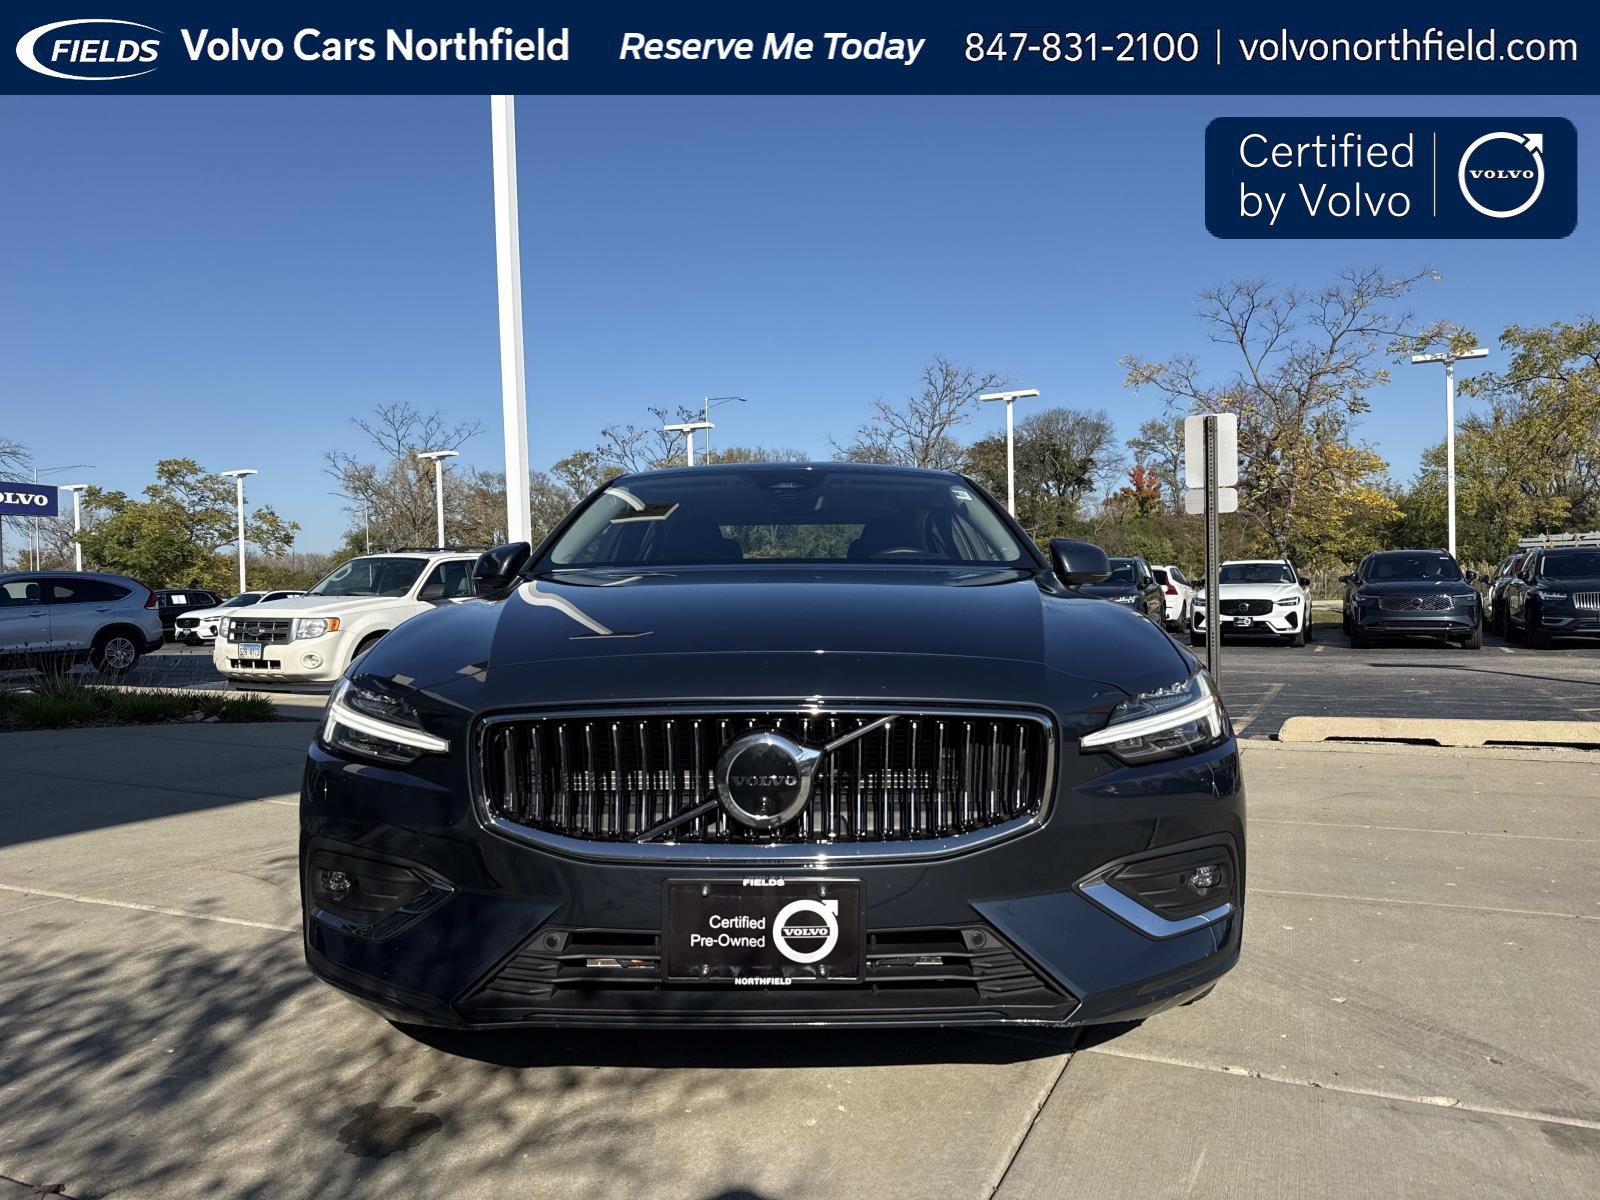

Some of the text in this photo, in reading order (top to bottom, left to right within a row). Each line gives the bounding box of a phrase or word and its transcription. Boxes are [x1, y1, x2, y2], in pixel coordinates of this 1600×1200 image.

[731, 775, 798, 787] VOLVO
[742, 878, 785, 887] FIELDS
[708, 914, 766, 930] Certified
[782, 927, 828, 937] VOLVO
[690, 933, 766, 948] Pre-Owned
[734, 977, 792, 986] NORTHFIELD
